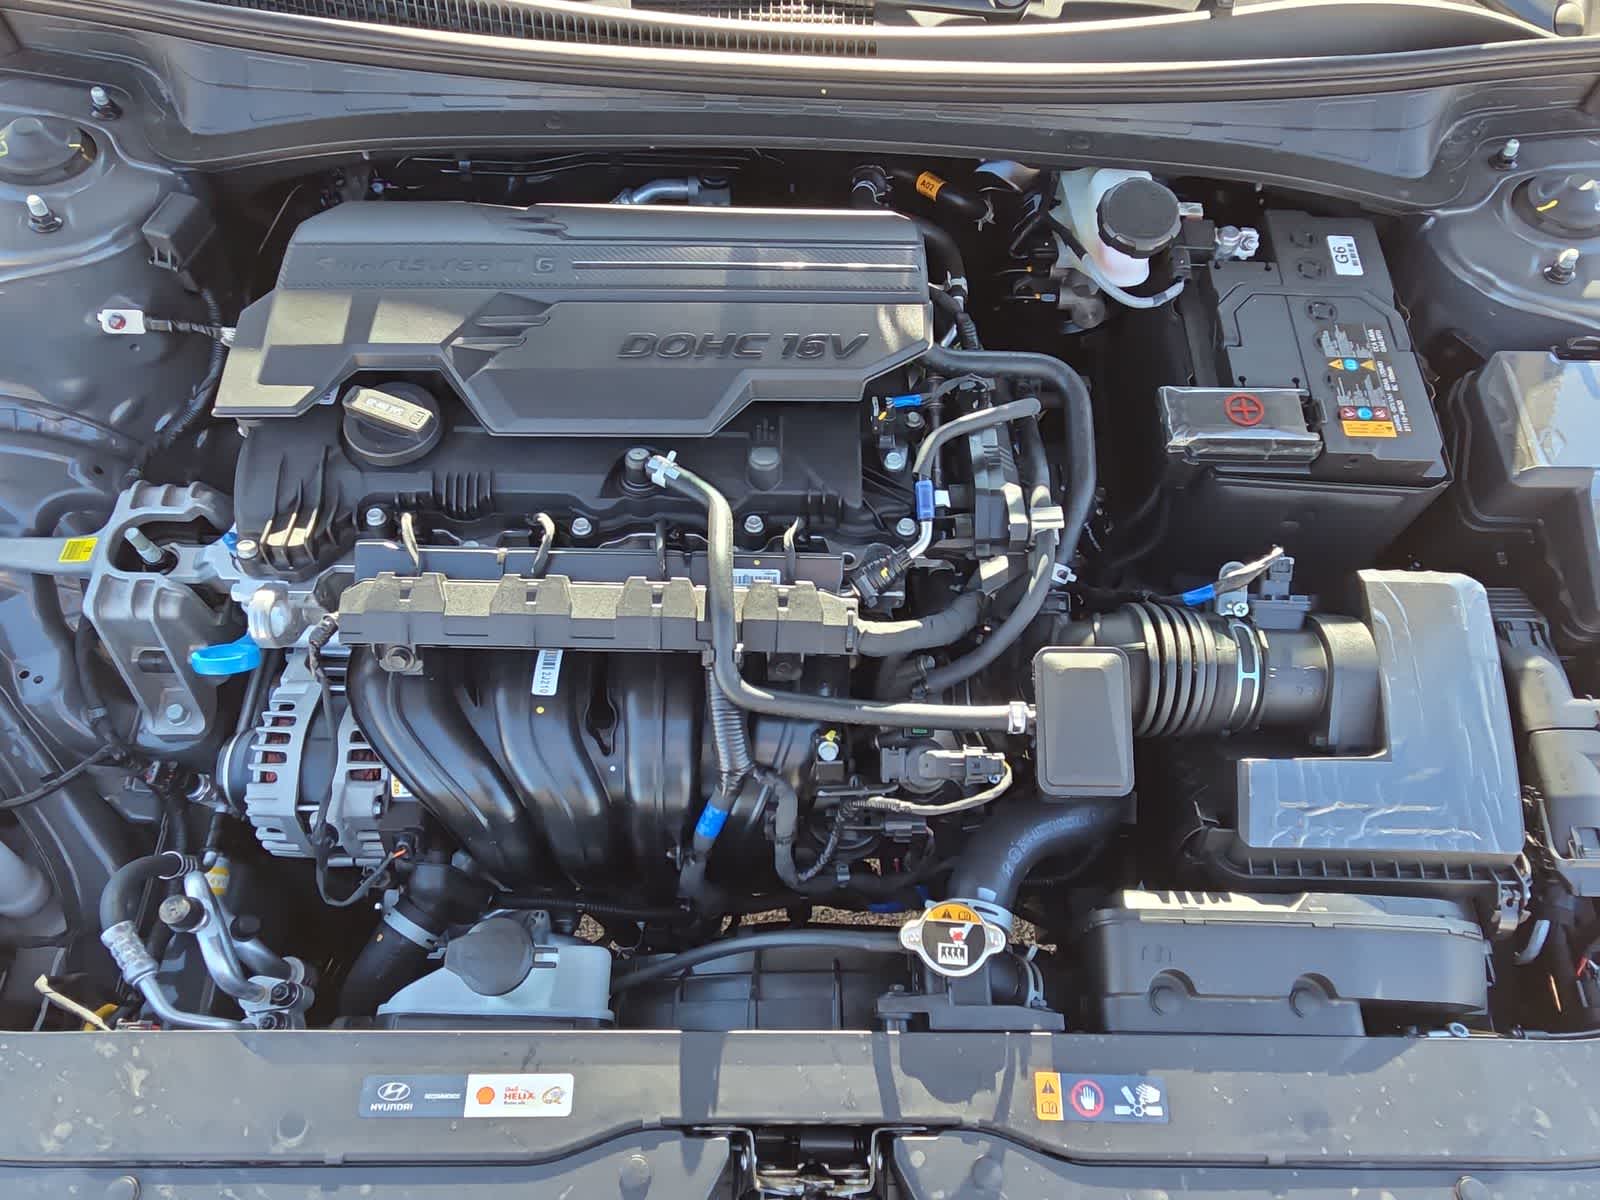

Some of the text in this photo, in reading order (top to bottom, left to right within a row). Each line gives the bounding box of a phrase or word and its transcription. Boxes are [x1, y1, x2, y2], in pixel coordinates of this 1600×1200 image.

[1333, 246, 1349, 264] G6
[535, 256, 554, 273] G
[616, 331, 870, 359] DOHC 16V
[503, 1092, 535, 1100] HELIX
[370, 1102, 414, 1113] HYUNDAI
